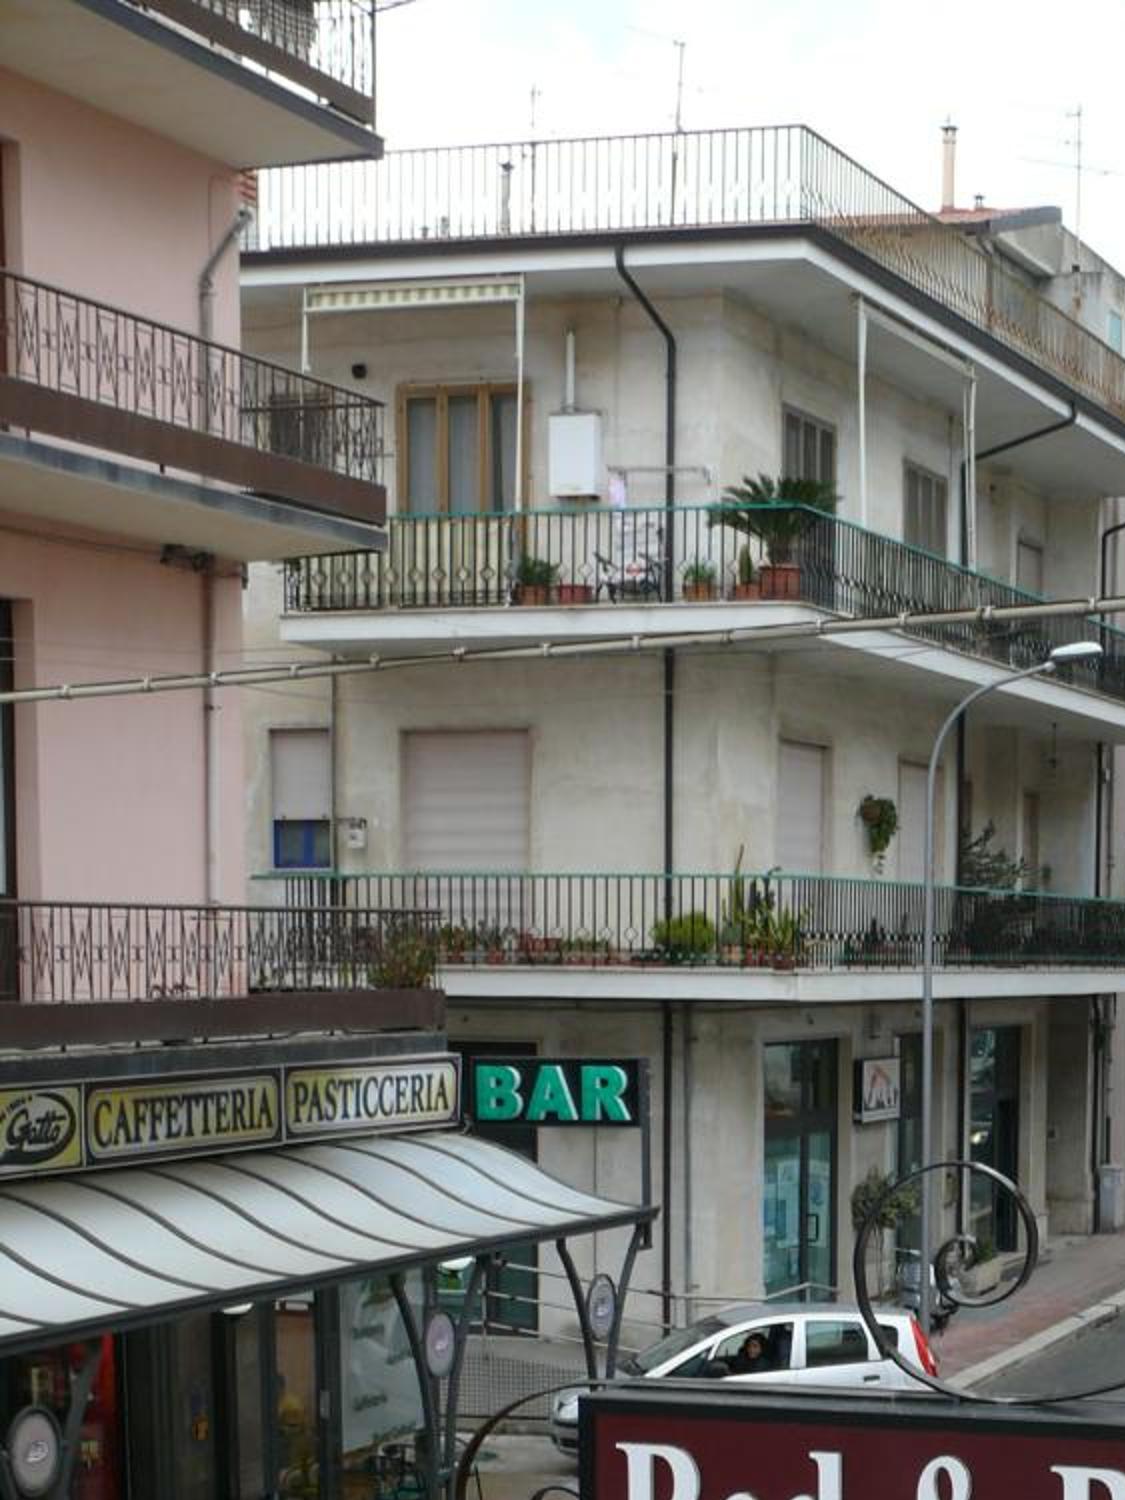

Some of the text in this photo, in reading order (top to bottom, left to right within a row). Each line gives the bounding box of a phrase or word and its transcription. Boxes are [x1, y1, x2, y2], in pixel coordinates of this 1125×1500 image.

[93, 1087, 275, 1149] CAFFETTERIA
[292, 1071, 449, 1123] PASTICCERIA
[475, 1064, 632, 1122] BAR
[6, 1107, 67, 1150] Gatto
